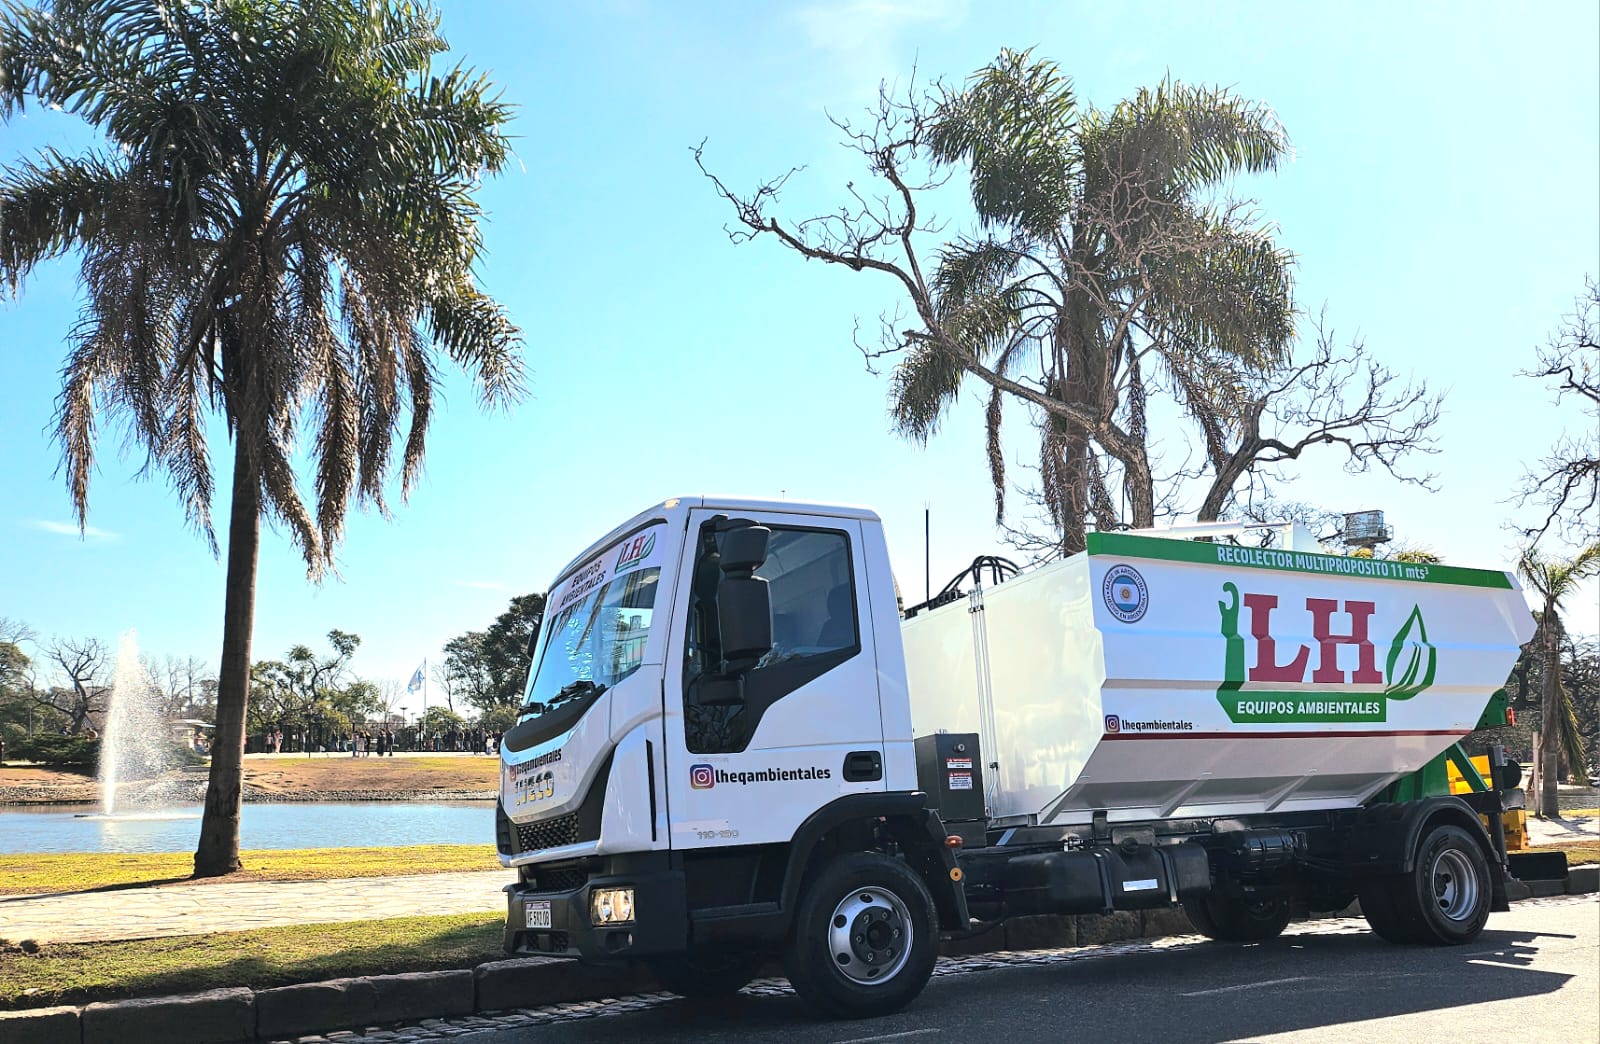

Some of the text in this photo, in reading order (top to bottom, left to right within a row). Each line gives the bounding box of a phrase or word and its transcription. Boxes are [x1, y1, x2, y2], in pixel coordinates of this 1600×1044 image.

[1217, 546, 1293, 568] RECOLECTOR
[1296, 556, 1388, 577] MULTIPROPOSITO
[1391, 564, 1403, 577] 11
[1243, 593, 1383, 683] LH
[1237, 701, 1380, 714] EQUIPOS AMBIENTALES
[1121, 719, 1193, 731] lheqambientales
[715, 766, 831, 785] lheqambientales
